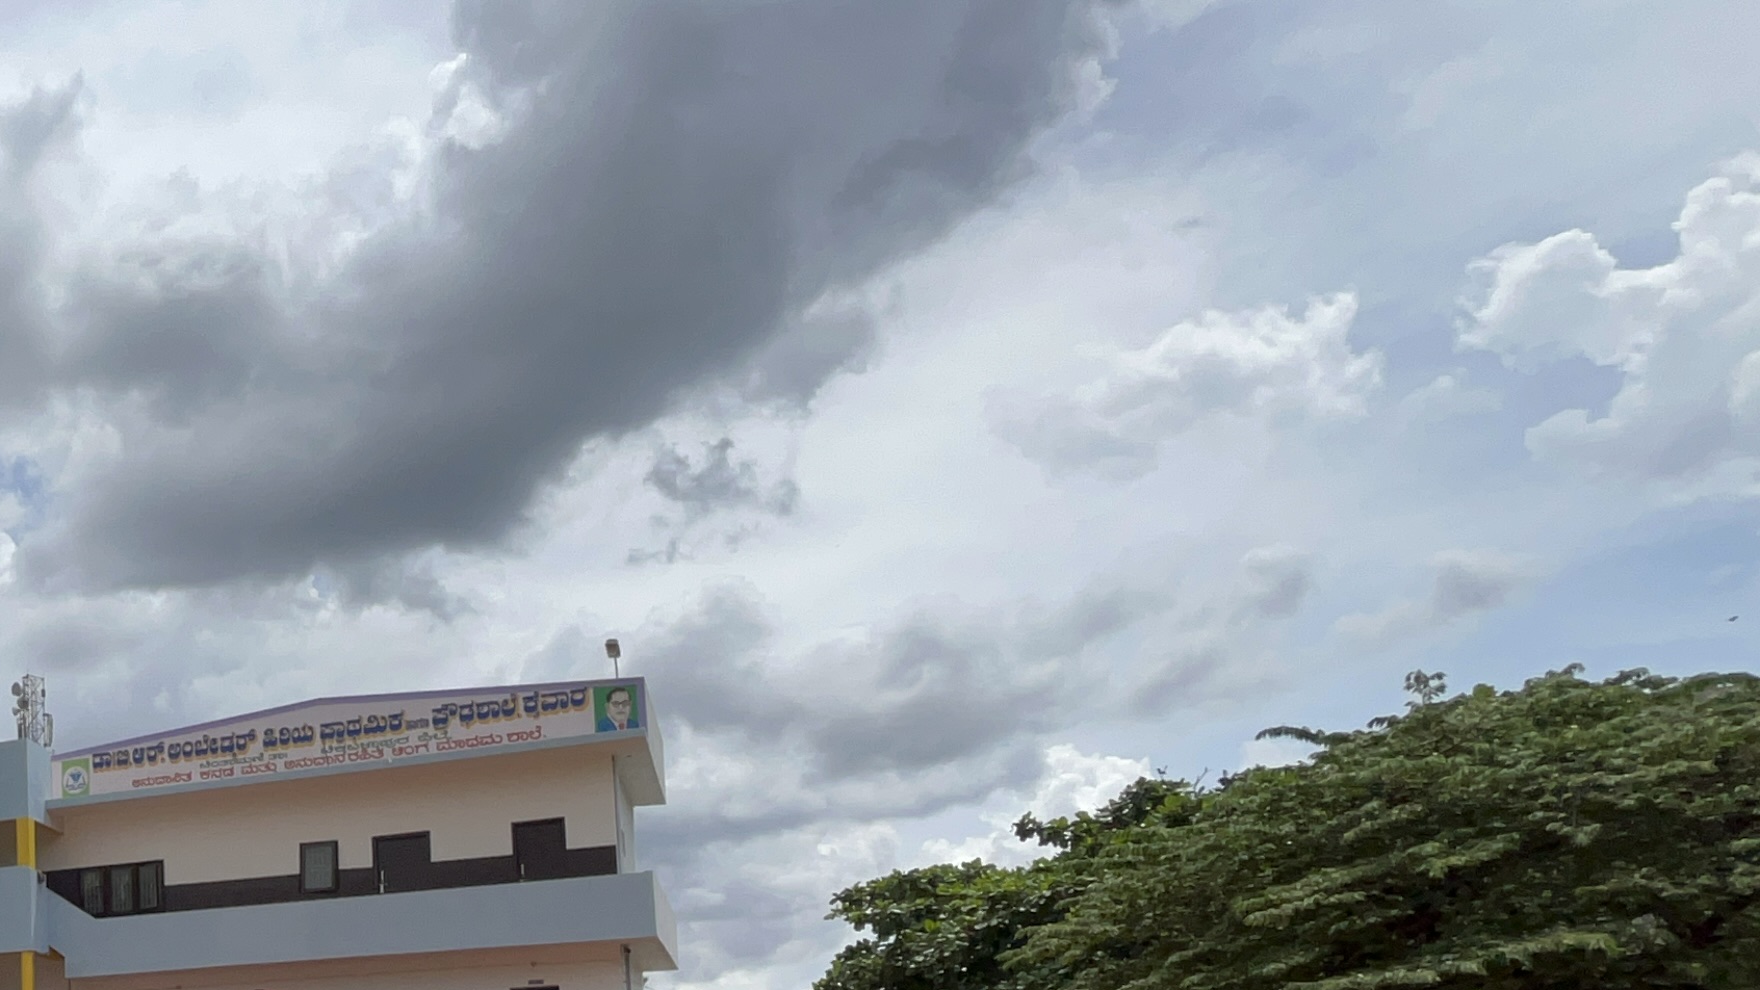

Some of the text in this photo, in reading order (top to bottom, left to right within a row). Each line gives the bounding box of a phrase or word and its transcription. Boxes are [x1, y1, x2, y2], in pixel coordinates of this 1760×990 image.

[263, 723, 316, 748] ಹಿರಿಯ
[320, 710, 405, 742] ಪ್ರಾಥಮಿಕ
[522, 686, 590, 717] ಕೈವಾರ
